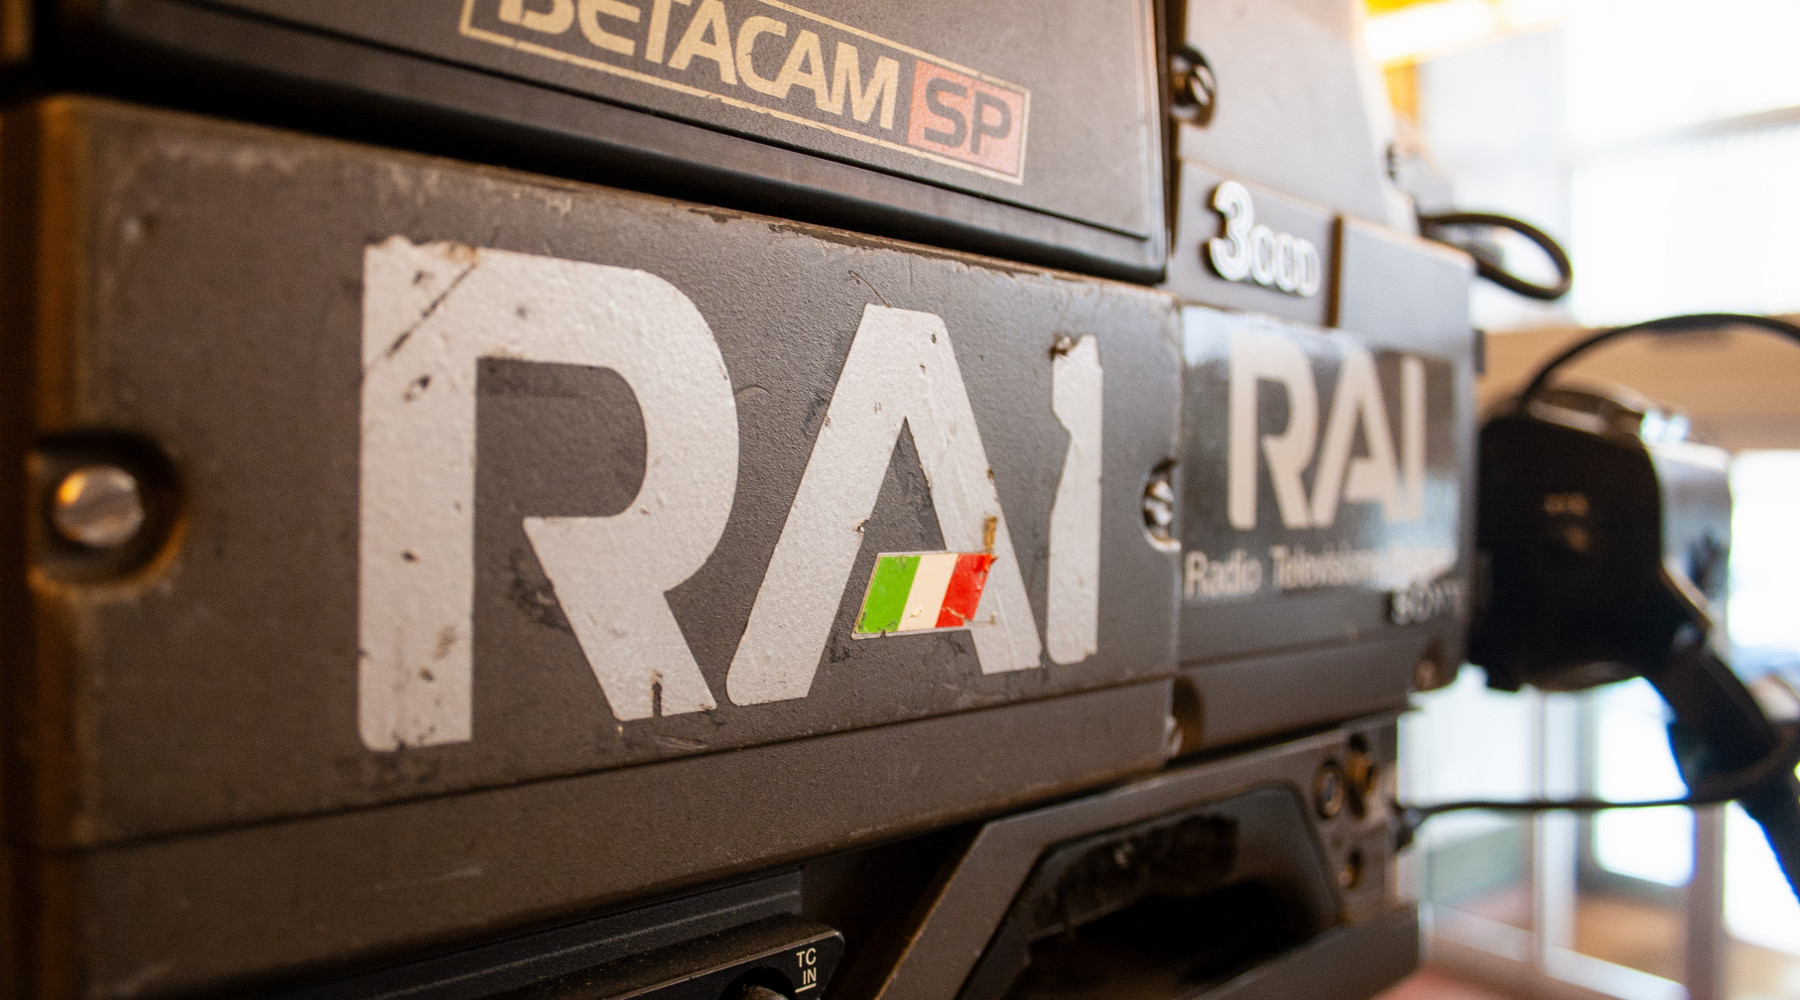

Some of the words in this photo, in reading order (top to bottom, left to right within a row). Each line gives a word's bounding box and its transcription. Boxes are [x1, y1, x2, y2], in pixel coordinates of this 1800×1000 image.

[922, 77, 1011, 156] SP
[1209, 181, 1321, 297] 3CCD
[1228, 330, 1426, 530] RAI
[359, 236, 1102, 752] RAI
[1184, 549, 1263, 598] Radio
[796, 947, 817, 968] TC
[803, 967, 817, 985] IN
